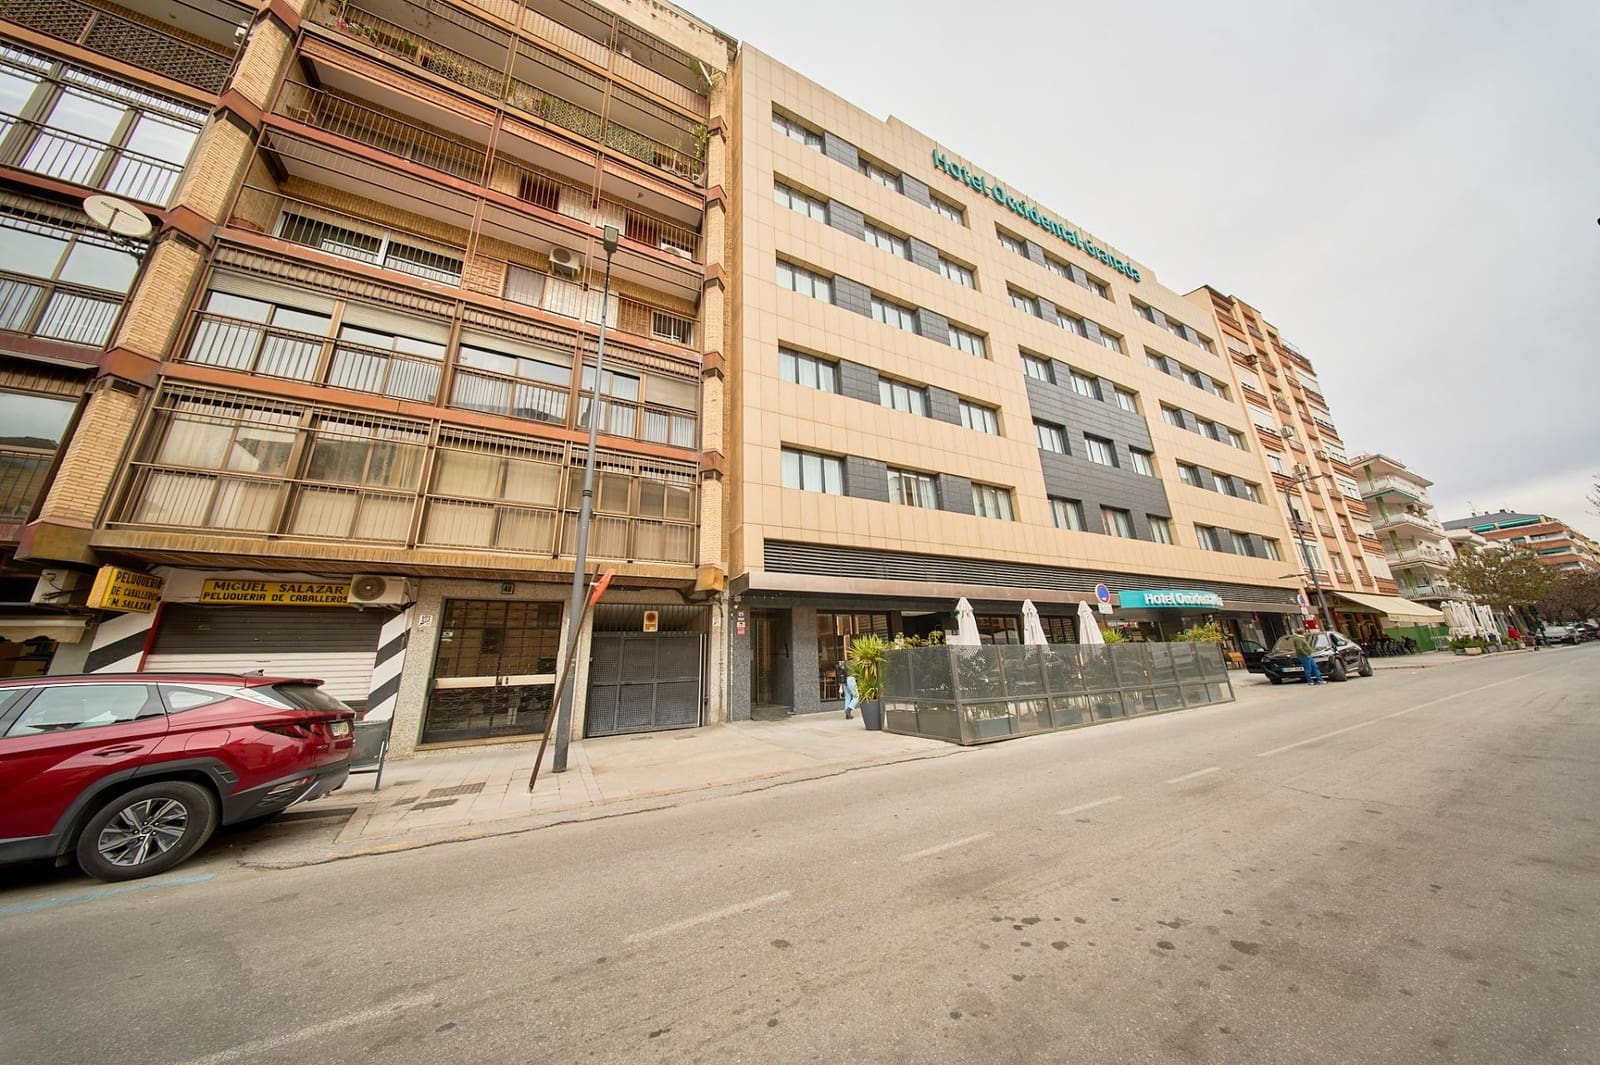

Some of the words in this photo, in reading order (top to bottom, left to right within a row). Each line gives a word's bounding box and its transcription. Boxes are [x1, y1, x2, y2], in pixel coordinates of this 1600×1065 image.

[932, 148, 990, 198] Hotel
[991, 183, 1082, 250] Occidental
[1084, 239, 1142, 283] Granada
[213, 582, 268, 592] MIGUEL
[279, 583, 344, 594] SALAZAR
[203, 592, 266, 601] PELUQUERIA
[271, 593, 284, 602] DE
[290, 594, 348, 603] CABALLEROS
[1144, 592, 1176, 605] Hotel
